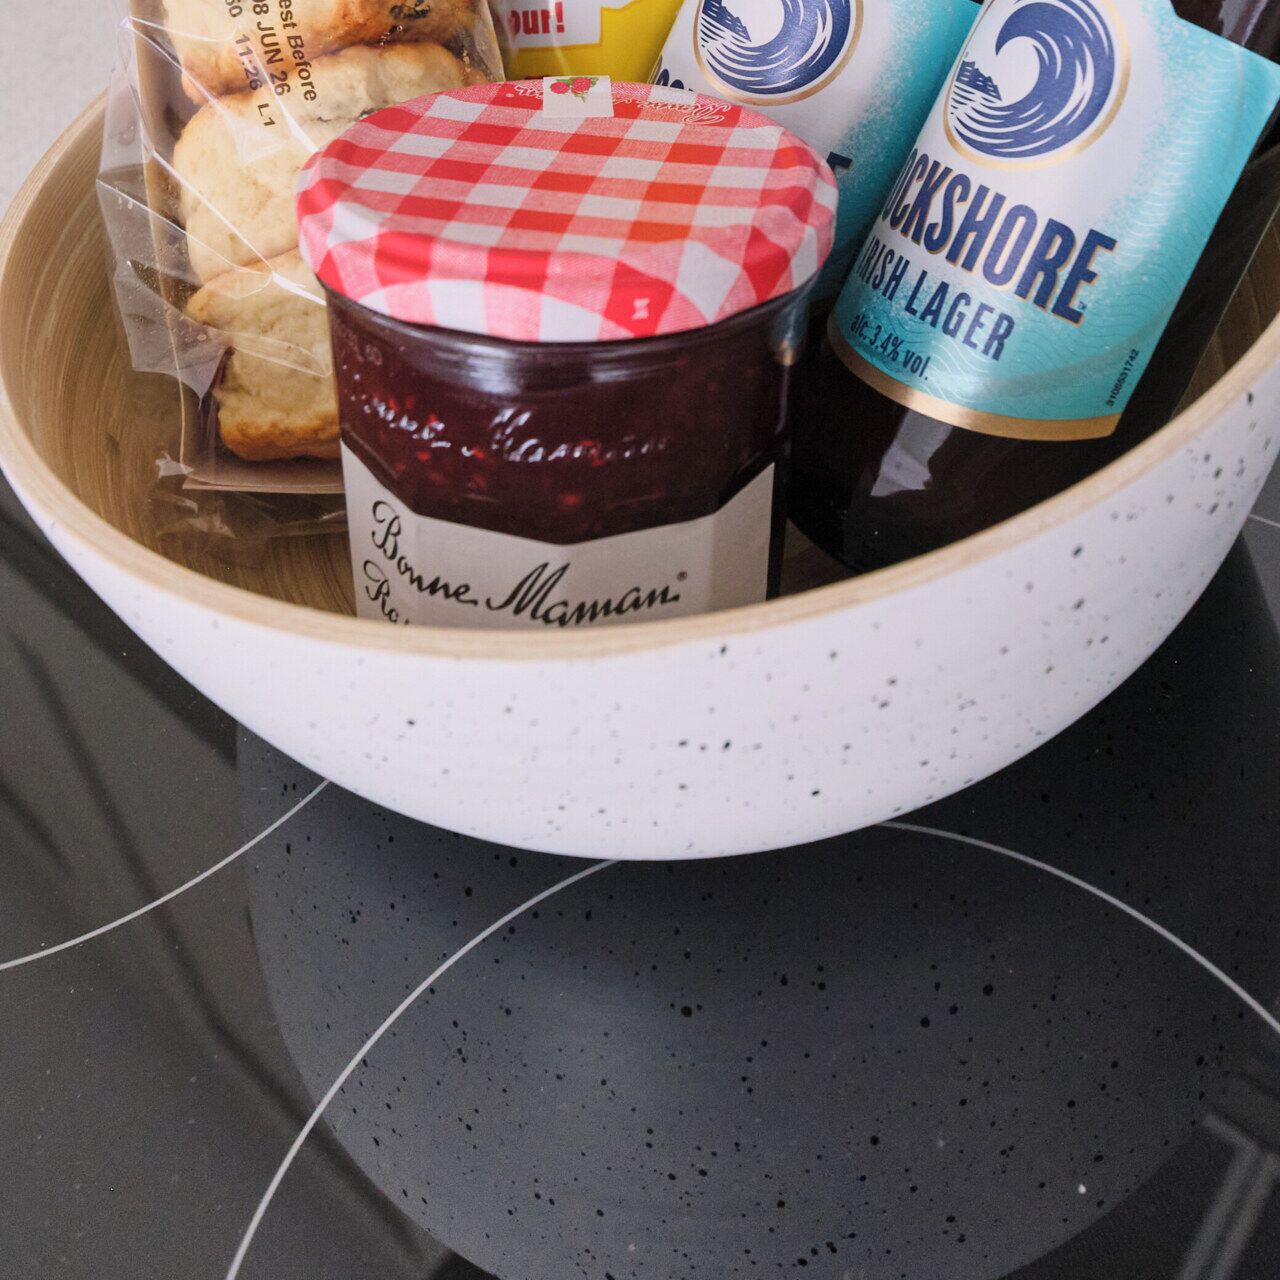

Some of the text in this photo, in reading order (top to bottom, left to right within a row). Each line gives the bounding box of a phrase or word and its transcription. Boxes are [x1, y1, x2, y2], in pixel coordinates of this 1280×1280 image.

[234, 33, 264, 92] 11:26
[257, 102, 276, 128] L1
[257, 20, 285, 66] JUN
[287, 34, 318, 103] Before
[269, 70, 292, 98] 26
[881, 147, 1118, 326] OCKSHORE
[869, 320, 901, 362] 3.4%
[900, 345, 930, 381] vol.
[904, 268, 1016, 362] LAGER
[371, 499, 478, 607] Bonne
